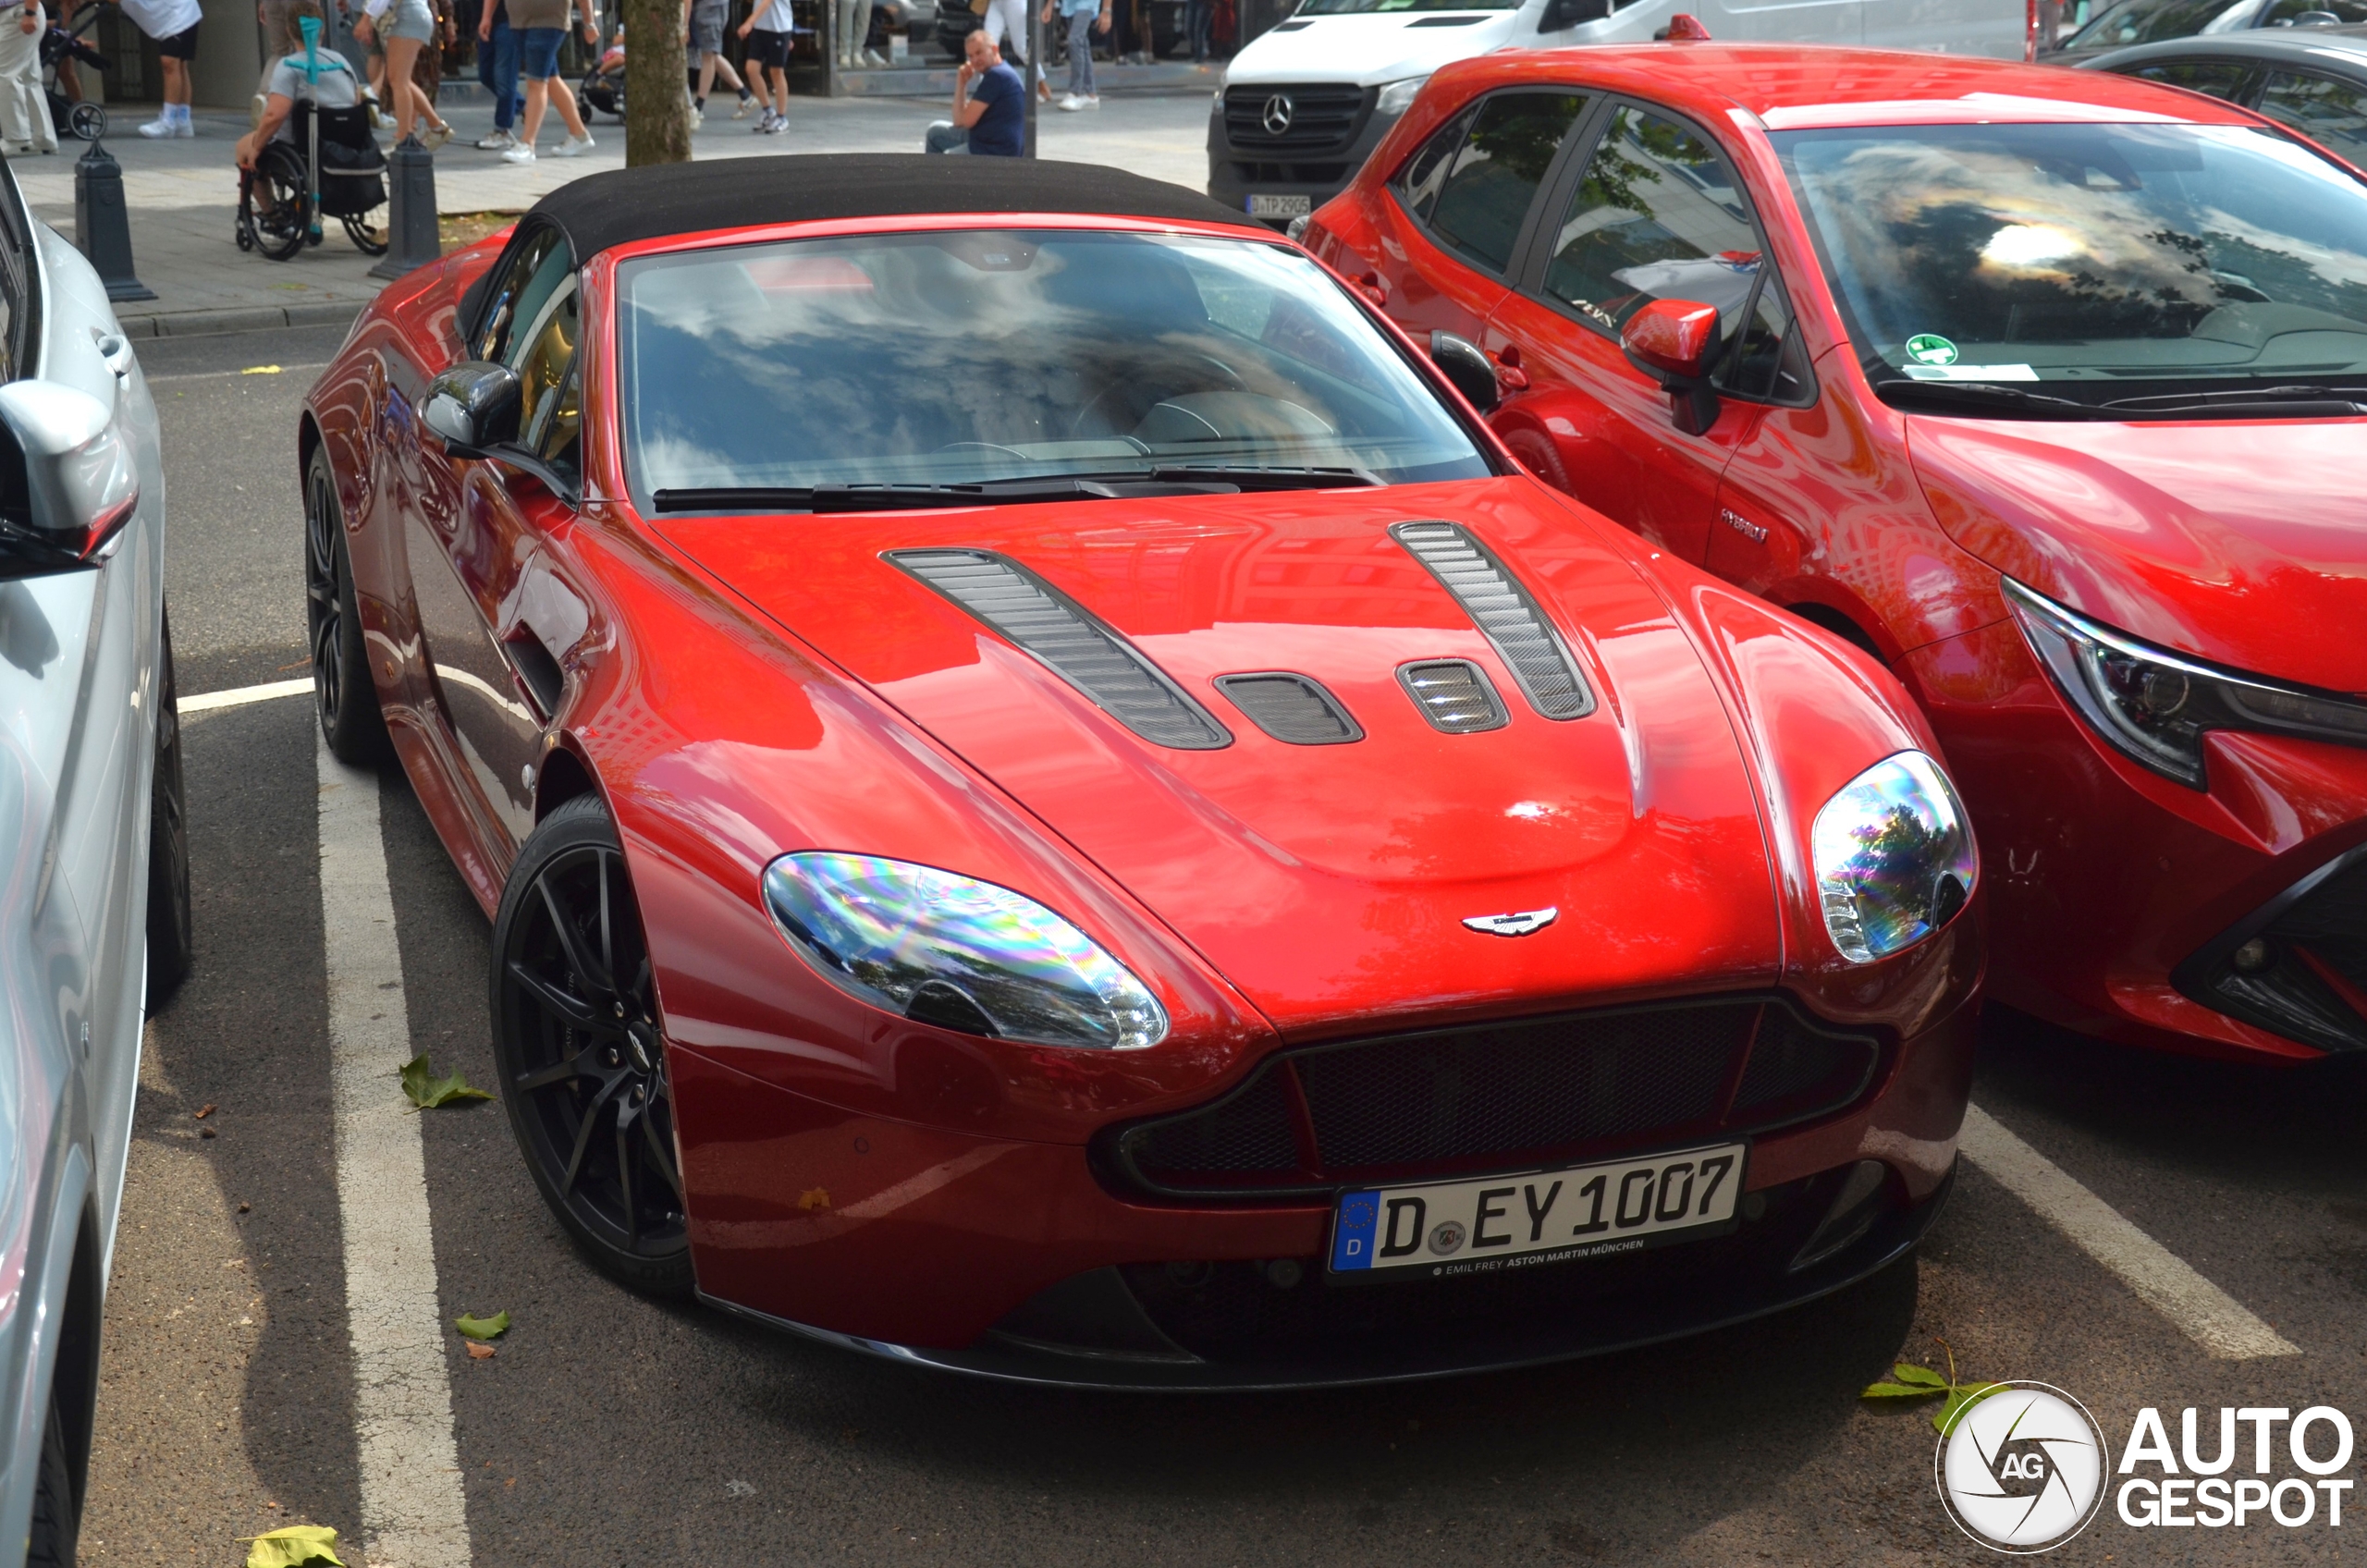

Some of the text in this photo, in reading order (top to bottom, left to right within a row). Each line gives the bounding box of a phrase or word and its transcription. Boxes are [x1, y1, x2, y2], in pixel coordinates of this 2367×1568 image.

[1265, 197, 1279, 213] TP
[1281, 198, 1309, 214] 2905
[1921, 337, 1936, 349] 4
[1379, 1196, 1427, 1258] D
[1471, 1180, 1564, 1248] EY
[1573, 1154, 1735, 1236] 1007
[1345, 1238, 1362, 1256] D
[1445, 1238, 1645, 1276] EMIL FREY ASTON MARTIN MÜNCHEN
